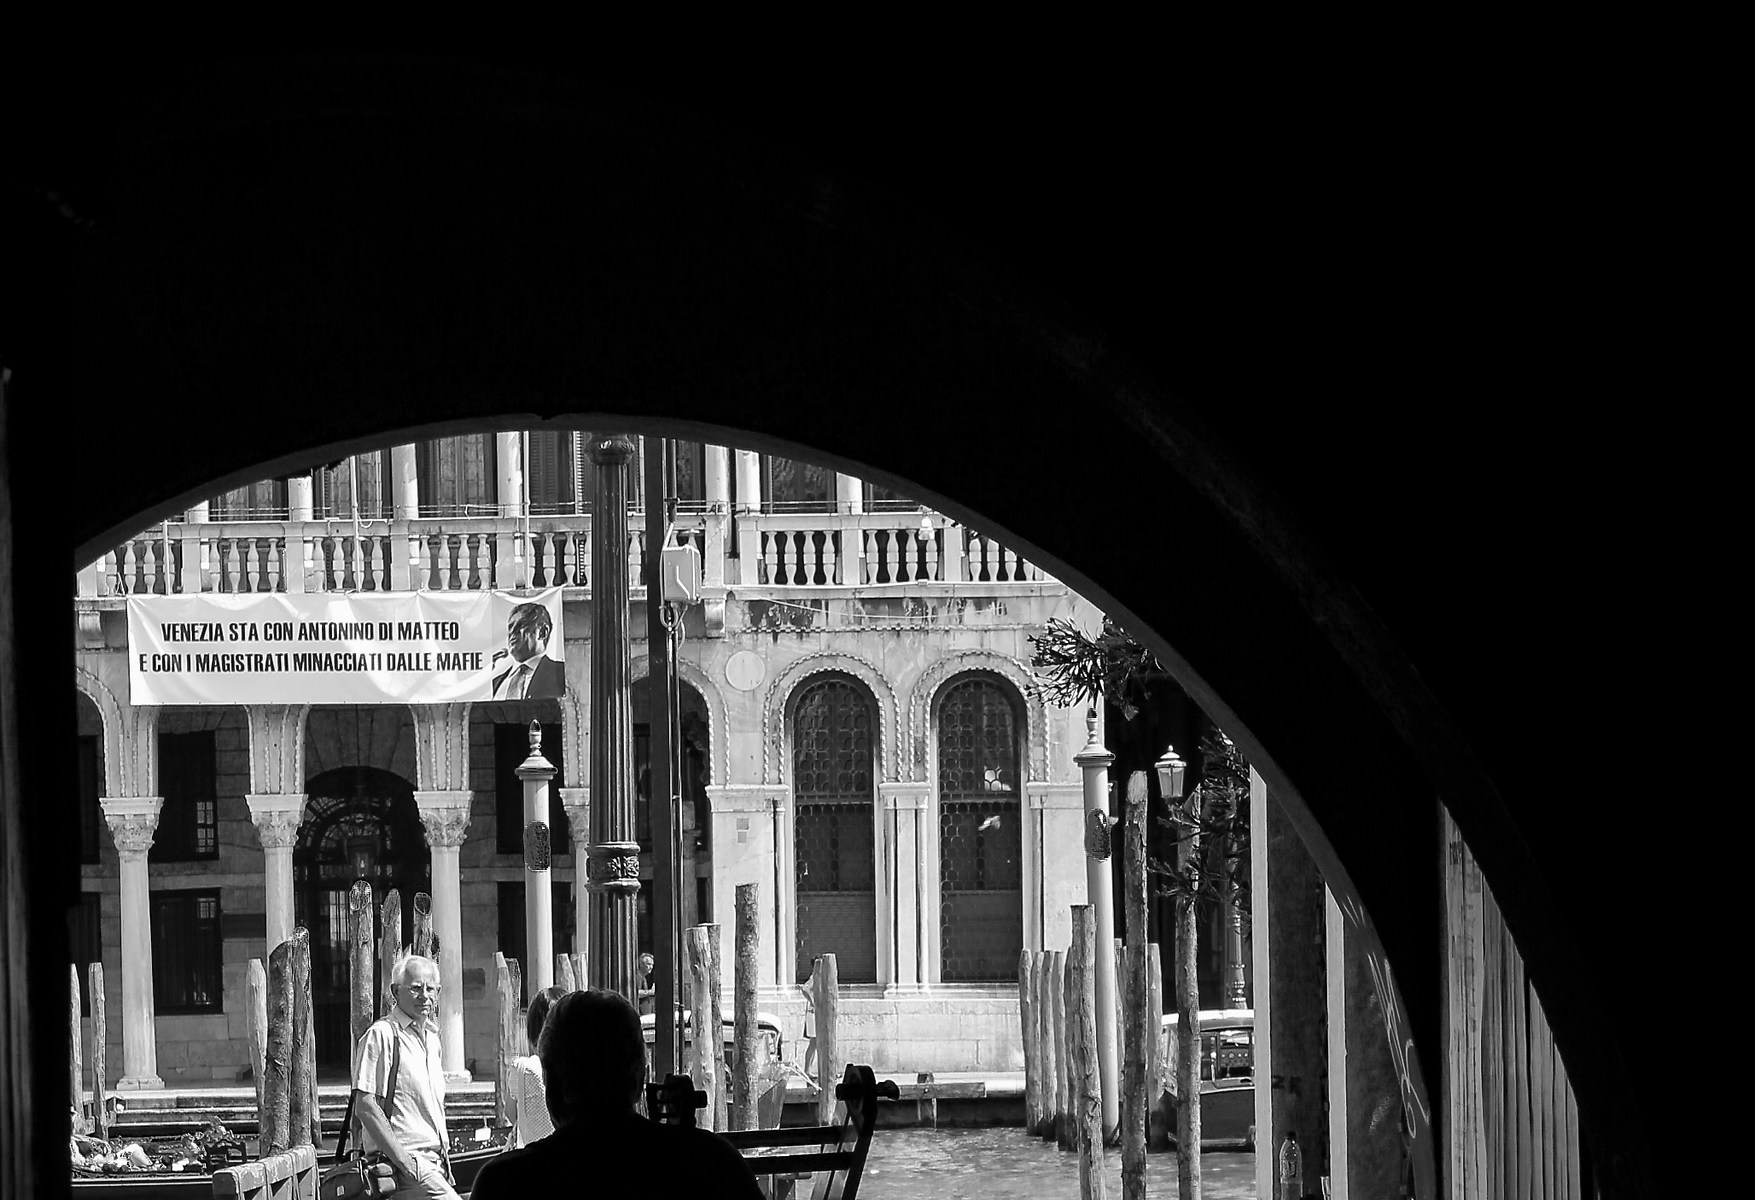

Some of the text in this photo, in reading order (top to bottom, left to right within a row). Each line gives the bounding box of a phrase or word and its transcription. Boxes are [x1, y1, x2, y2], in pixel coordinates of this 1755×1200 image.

[160, 621, 459, 642] VENEZIA STA CON ANTONINO DI MATTEO
[139, 652, 483, 673] E CON I MAGISTRATI MINACCIATI DALLE MAFIE
